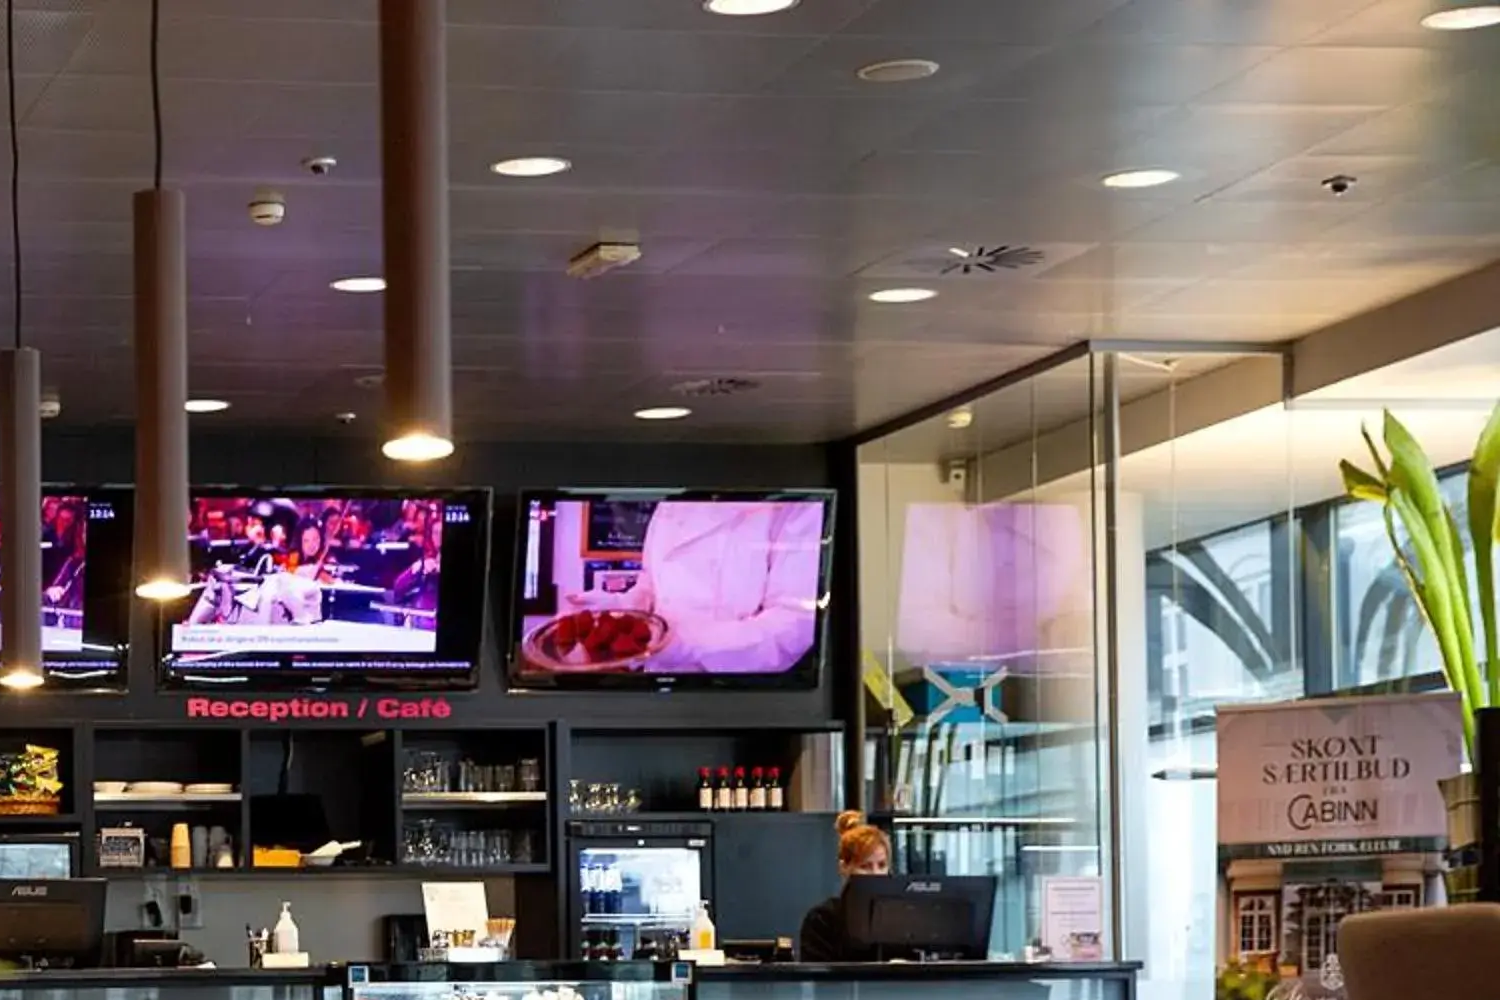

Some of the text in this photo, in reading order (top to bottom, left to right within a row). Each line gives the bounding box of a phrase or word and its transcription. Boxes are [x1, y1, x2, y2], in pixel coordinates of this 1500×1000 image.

[188, 696, 452, 721] Reception / Café
[1287, 794, 1379, 830] CABINN
